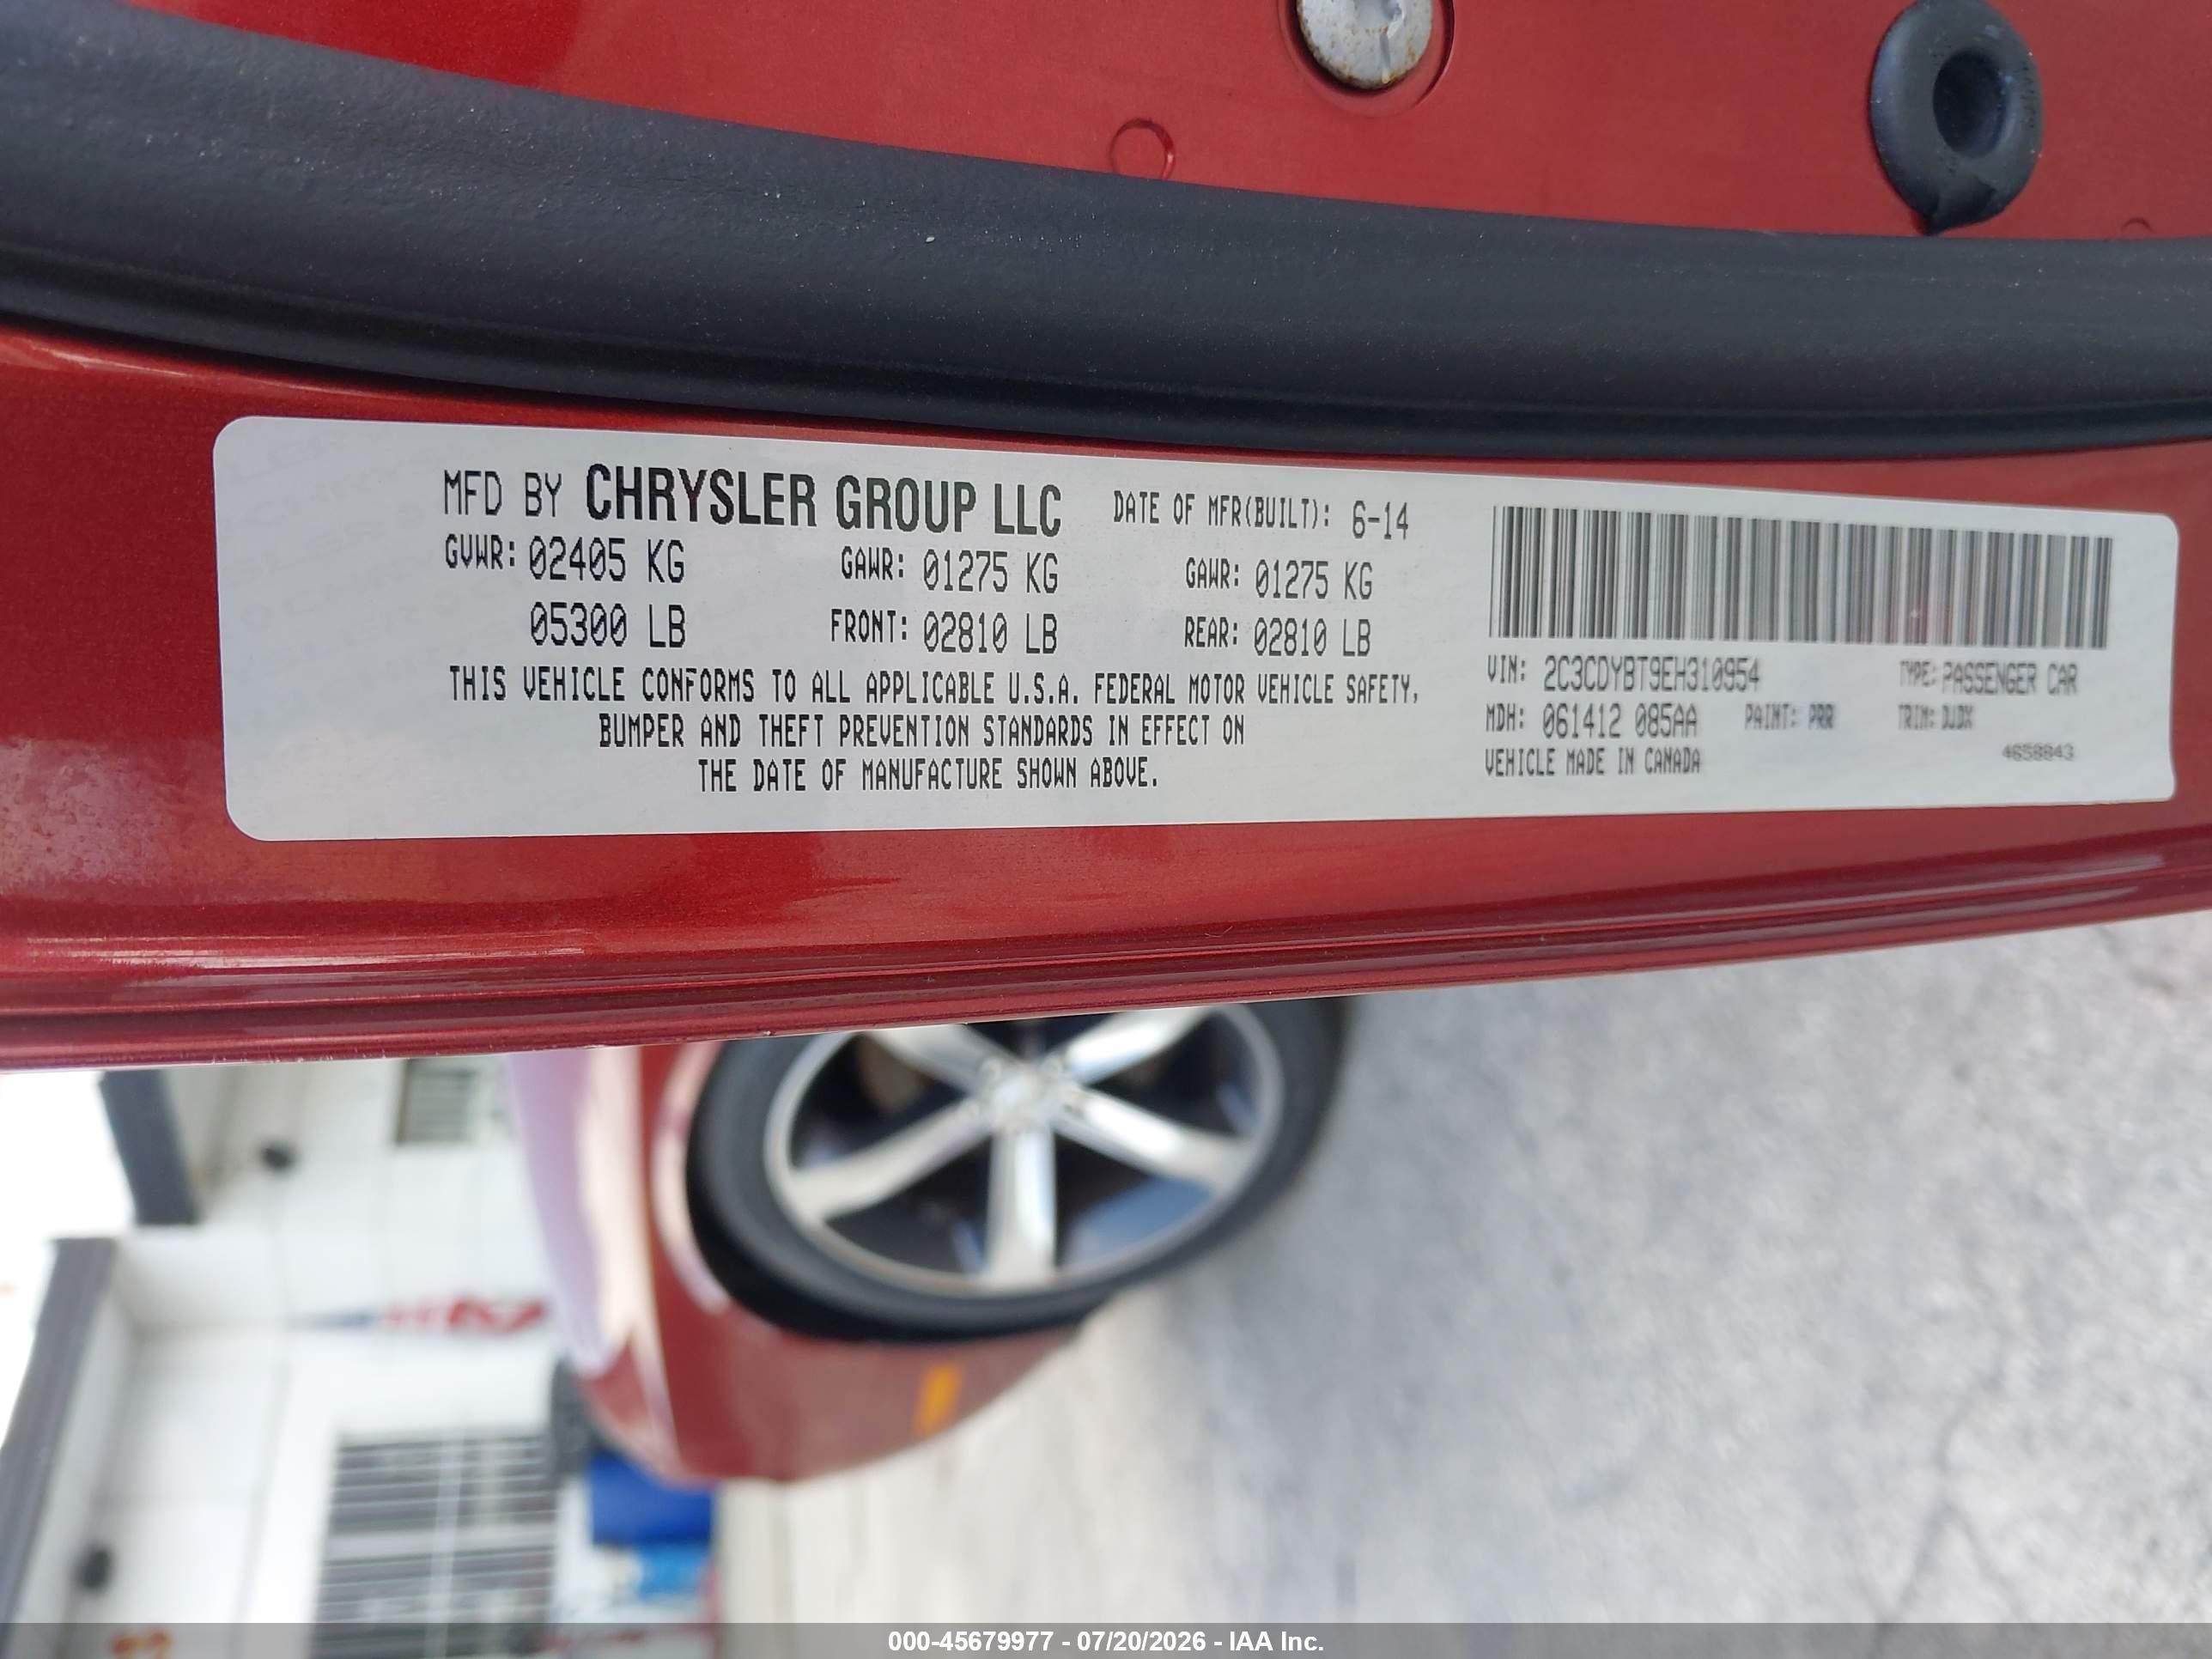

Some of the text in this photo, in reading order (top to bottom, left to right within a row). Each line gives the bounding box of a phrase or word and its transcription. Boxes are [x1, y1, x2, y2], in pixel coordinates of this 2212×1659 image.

[443, 462, 1061, 538] MFD BY CHRYSLER GROUP LLC
[1113, 489, 1409, 540] DATE OF MFR(BUILT): 6-14
[445, 532, 685, 584] GVWR: 02405 KG
[841, 544, 1059, 594] GAWR: 01275 KG
[1185, 556, 1373, 601] GAWR: 01275 KG
[530, 600, 686, 649] 05300 LB
[830, 608, 1058, 655] FRONT: 02810 LB
[1183, 615, 1371, 658] REAR: 02810 LB
[449, 665, 1418, 708] THIS VEHICLE CONFORMS TO ALL APPLICABLE U.S.A. FEDERAL MOTOR VEHICLE SAFETY,
[1487, 653, 1759, 693] VIN: 2C3CDYBT9EH310954
[1899, 659, 2078, 695] TYPE: PASSENGER CAR
[598, 712, 1244, 748] BUMPER AND THEFT PREVENTION STANDARDS IN EFFECT ON
[1485, 700, 1698, 740] MDH: 061412 085AA
[1744, 702, 1836, 731] PAINT: PRR
[1898, 703, 1936, 731] TRIM:
[697, 755, 1158, 793] THE DATE OF MANUFACTURE SHOWN ABOVE.
[1485, 745, 1703, 778] VEHICLE MADE IN CANADA
